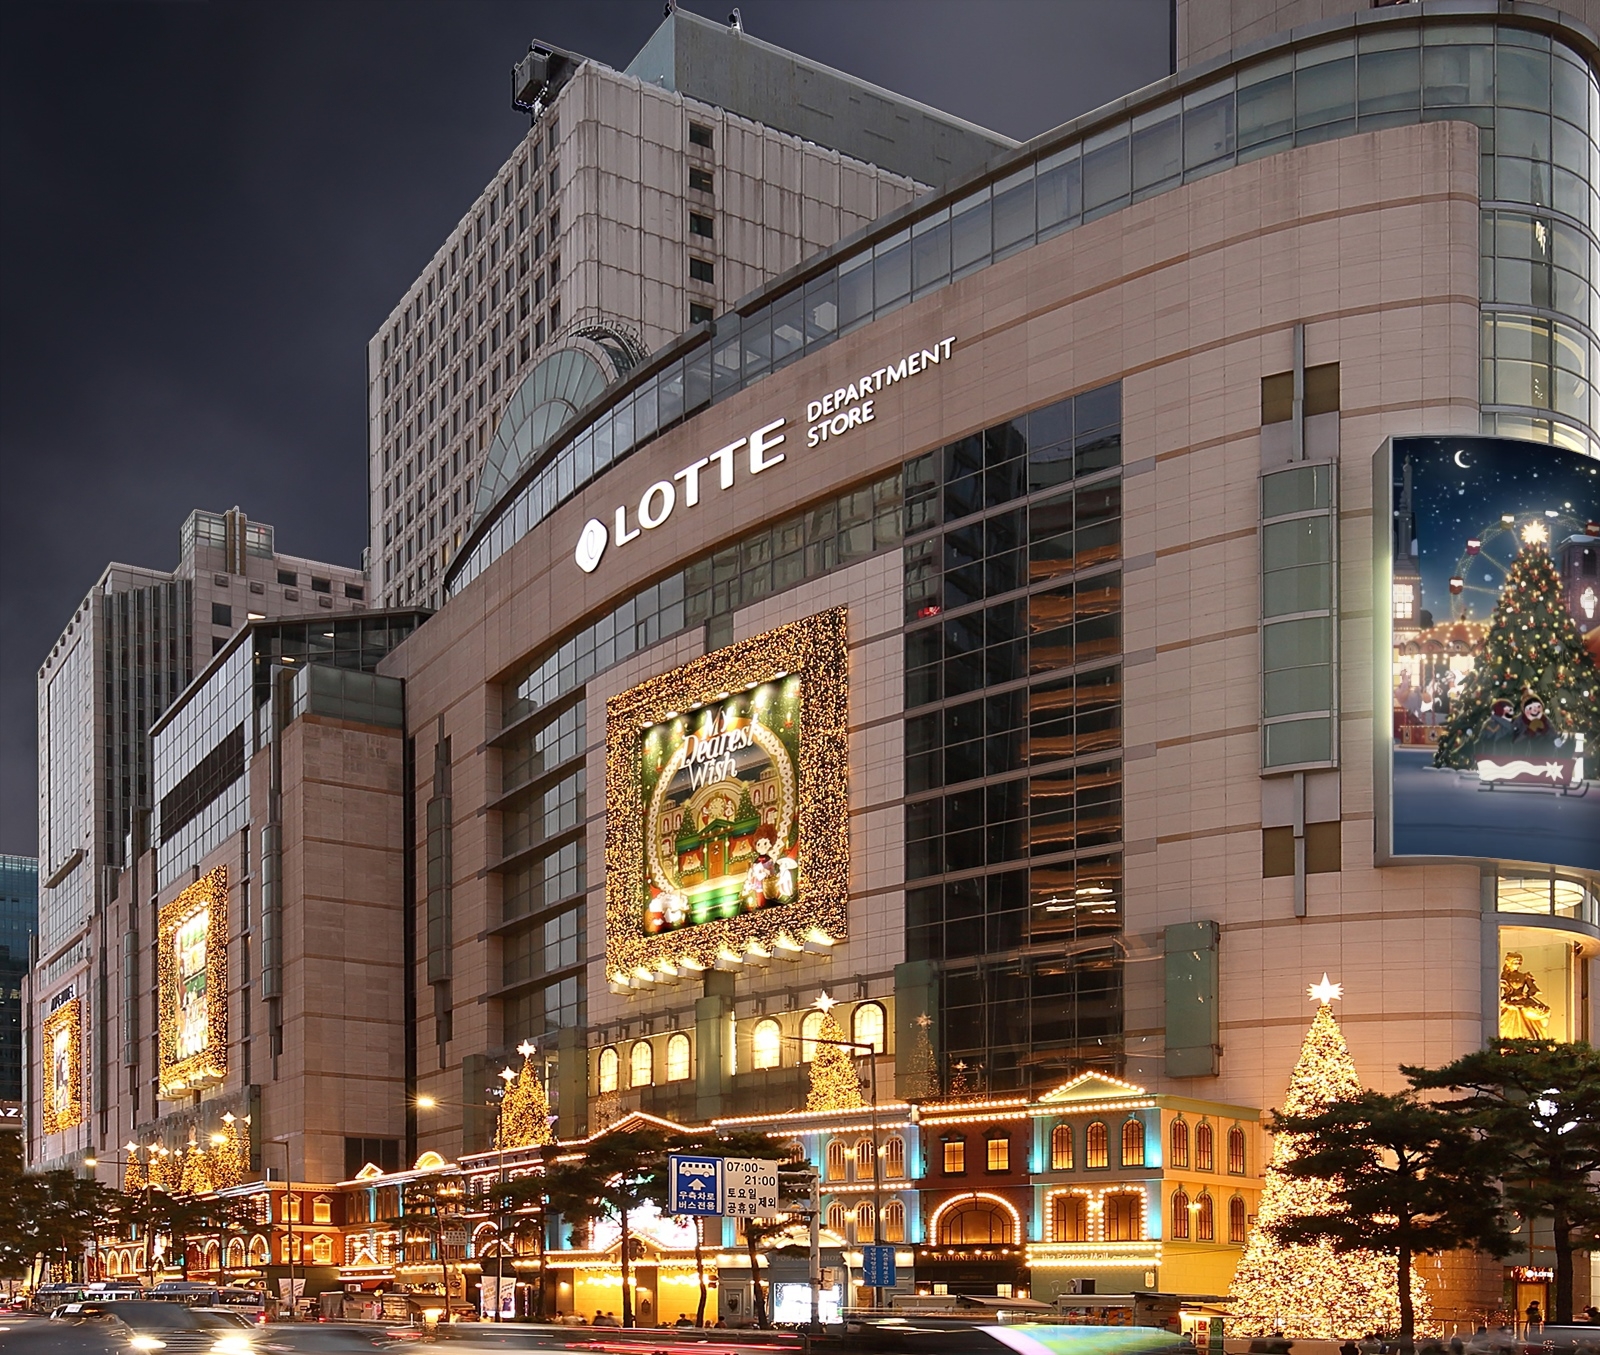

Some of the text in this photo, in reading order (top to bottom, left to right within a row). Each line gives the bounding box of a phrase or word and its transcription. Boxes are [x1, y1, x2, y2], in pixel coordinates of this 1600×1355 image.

[807, 336, 957, 424] DEPARTMENT
[807, 400, 875, 448] STORE
[615, 417, 786, 547] LOTTE
[702, 706, 735, 739] My
[679, 713, 759, 770] Dearest
[688, 750, 738, 792] Wish
[727, 1162, 765, 1173] 07:00~
[744, 1175, 776, 1186] 21:00
[678, 1191, 716, 1201] 우측차로
[727, 1188, 757, 1199] 토요일
[678, 1200, 716, 1210] 버스전용
[727, 1202, 757, 1215] 공휴일
[758, 1196, 775, 1208] 제외
